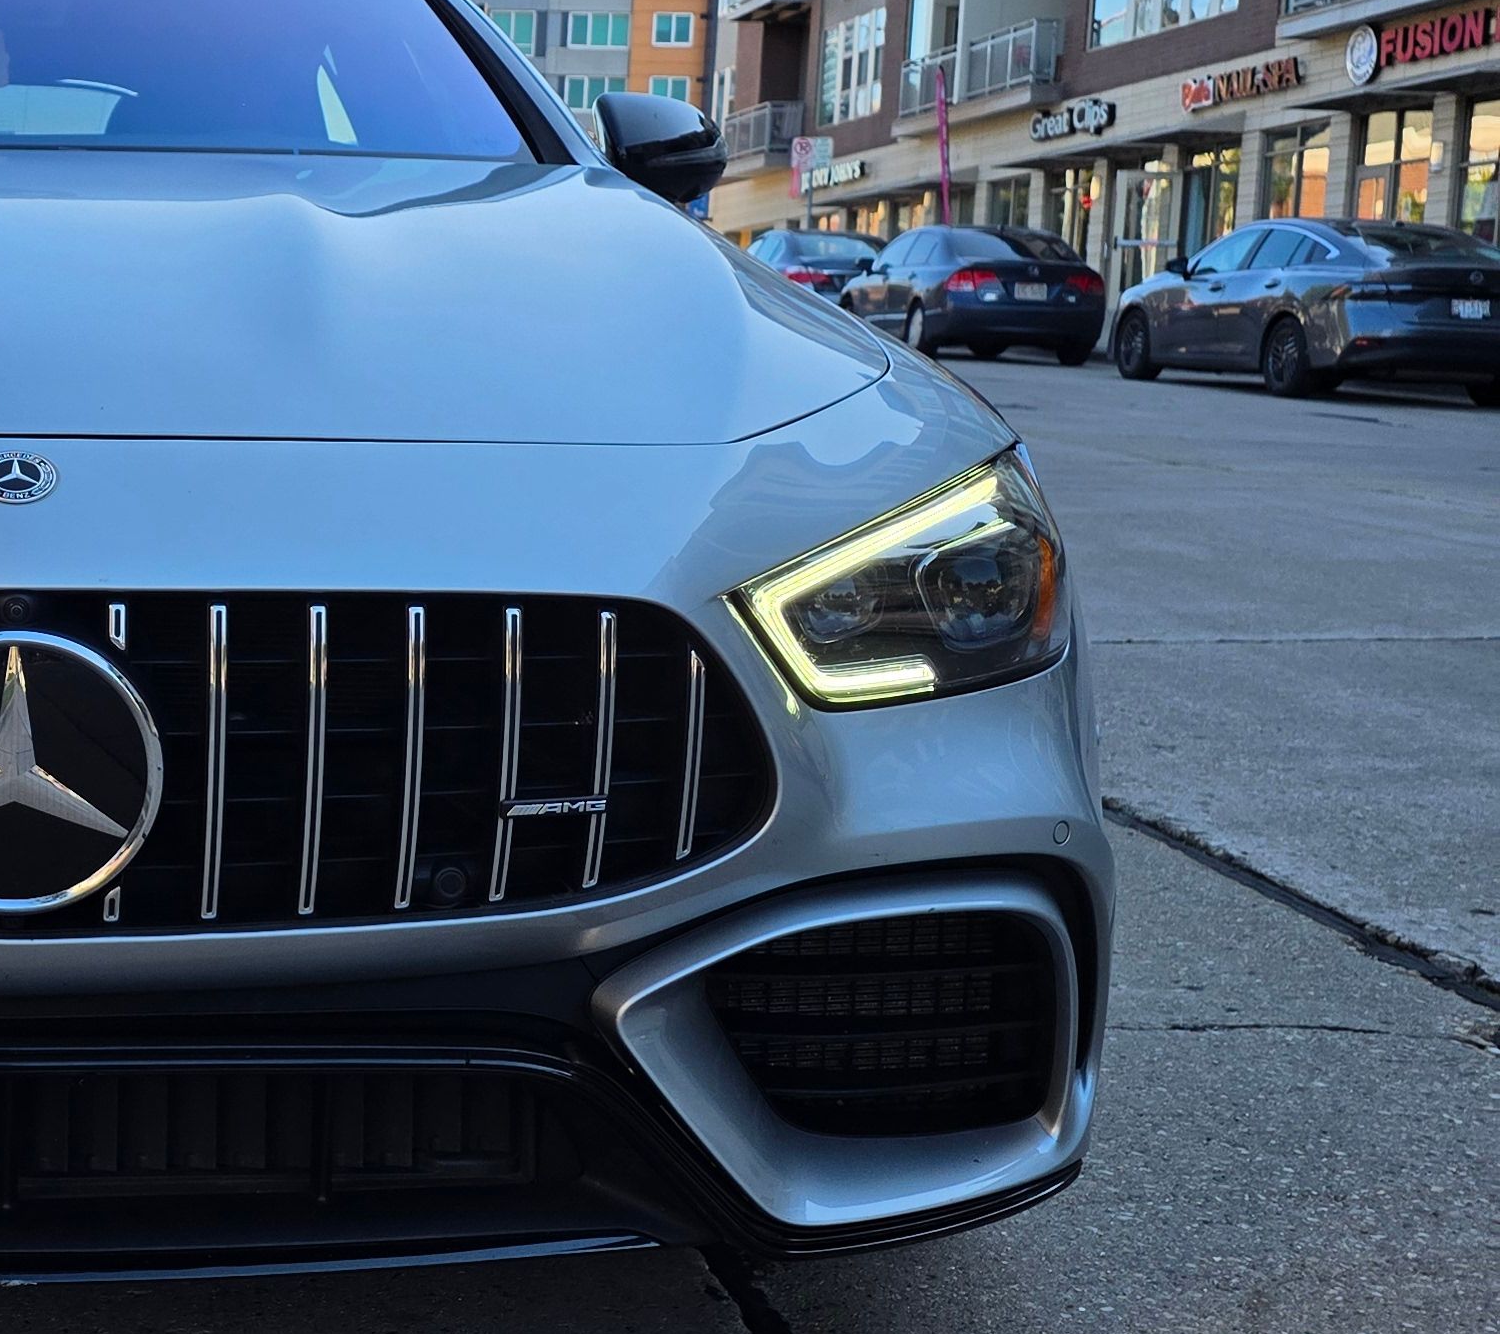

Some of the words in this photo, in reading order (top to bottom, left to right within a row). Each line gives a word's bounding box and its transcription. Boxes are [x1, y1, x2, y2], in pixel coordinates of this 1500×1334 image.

[1380, 10, 1485, 68] FUSION
[1030, 112, 1070, 139] Great
[1073, 99, 1109, 134] Clips
[538, 799, 607, 815] AMG
